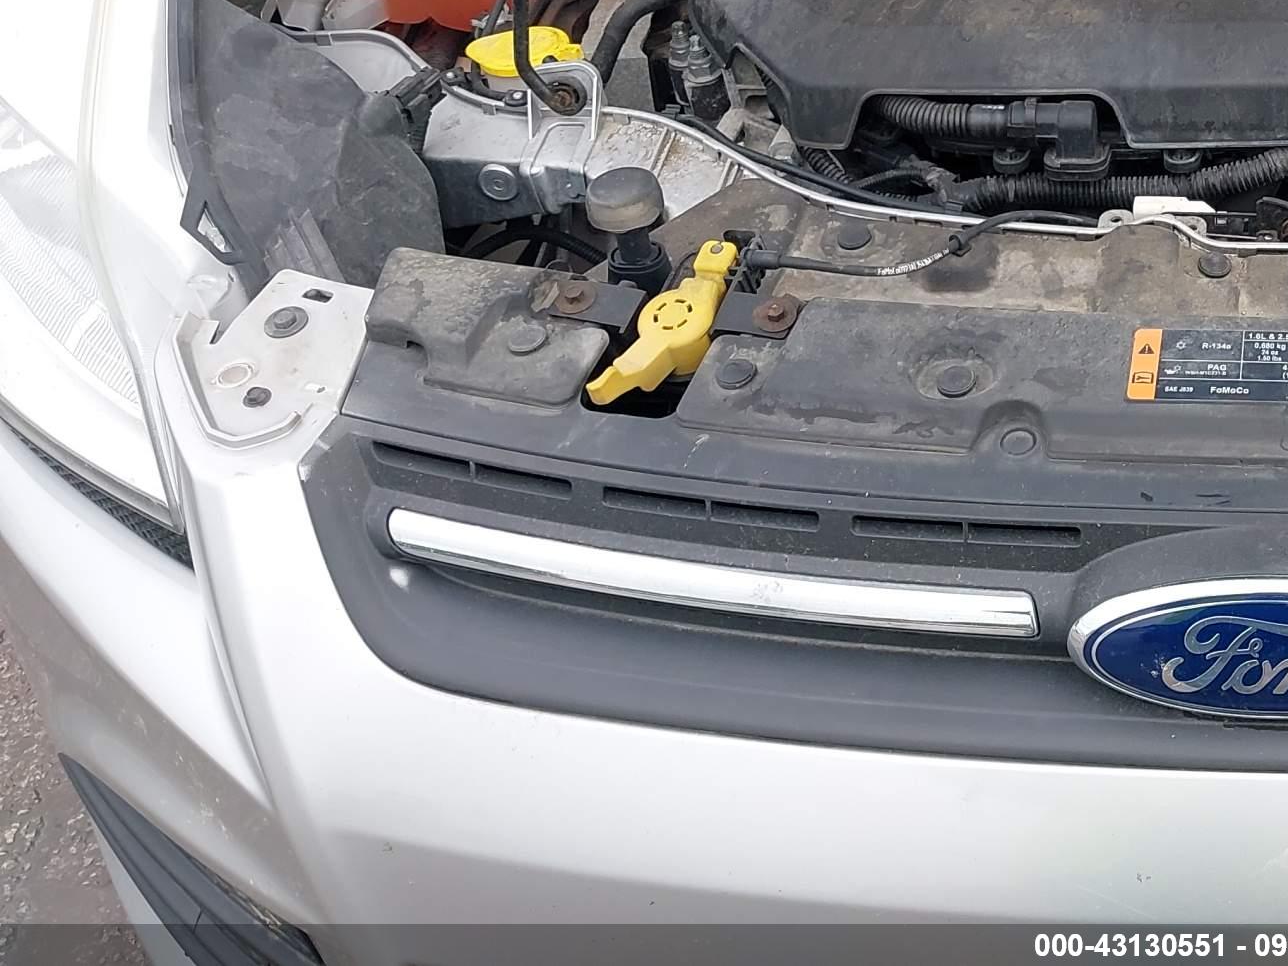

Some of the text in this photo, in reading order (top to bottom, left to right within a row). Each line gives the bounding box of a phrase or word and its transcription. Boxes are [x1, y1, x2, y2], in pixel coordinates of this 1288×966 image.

[1202, 342, 1232, 350] R-134a
[1276, 343, 1287, 351] kg
[1207, 363, 1227, 371] PAG
[1210, 386, 1250, 394] FoMoCo
